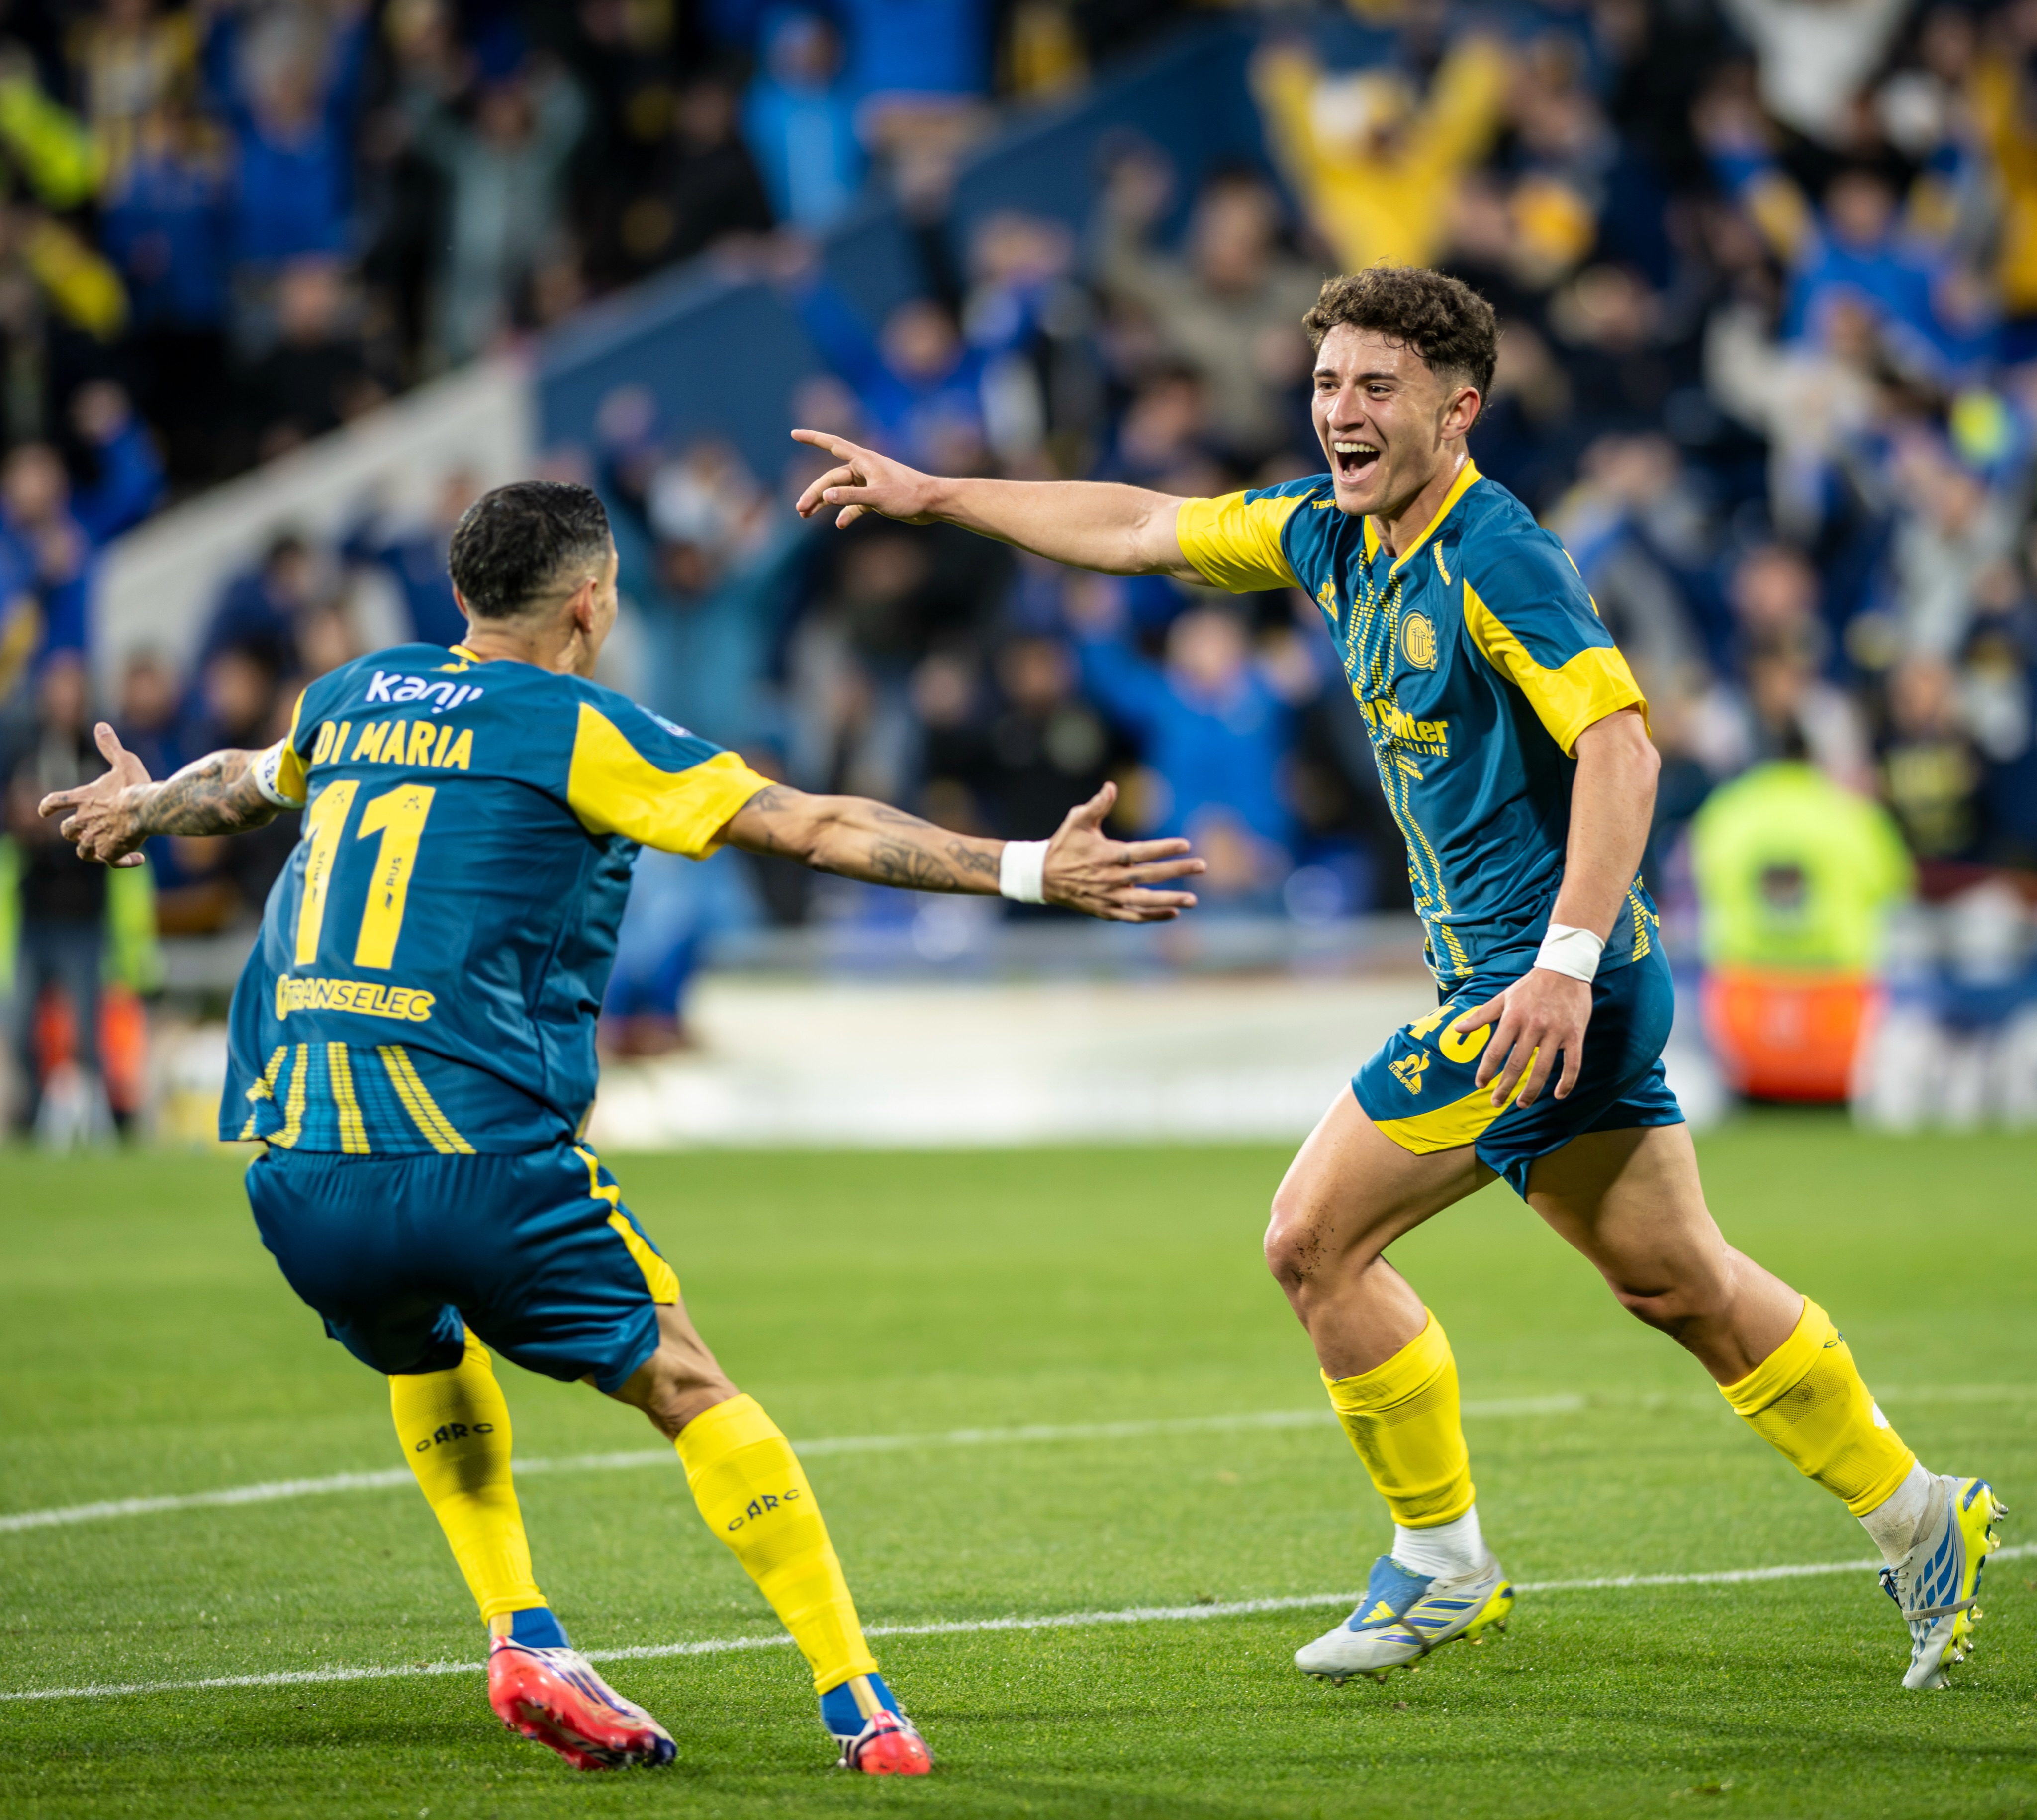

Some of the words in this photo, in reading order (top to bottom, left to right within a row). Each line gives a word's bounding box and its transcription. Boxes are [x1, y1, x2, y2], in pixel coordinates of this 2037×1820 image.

[311, 720, 351, 765] DI
[351, 719, 474, 770] MARIA
[1393, 738, 1449, 758] ONLINE
[294, 779, 436, 970] 11
[1388, 1062, 1397, 1071] LE
[416, 1422, 494, 1452] CARC
[728, 1489, 800, 1531] CARC
